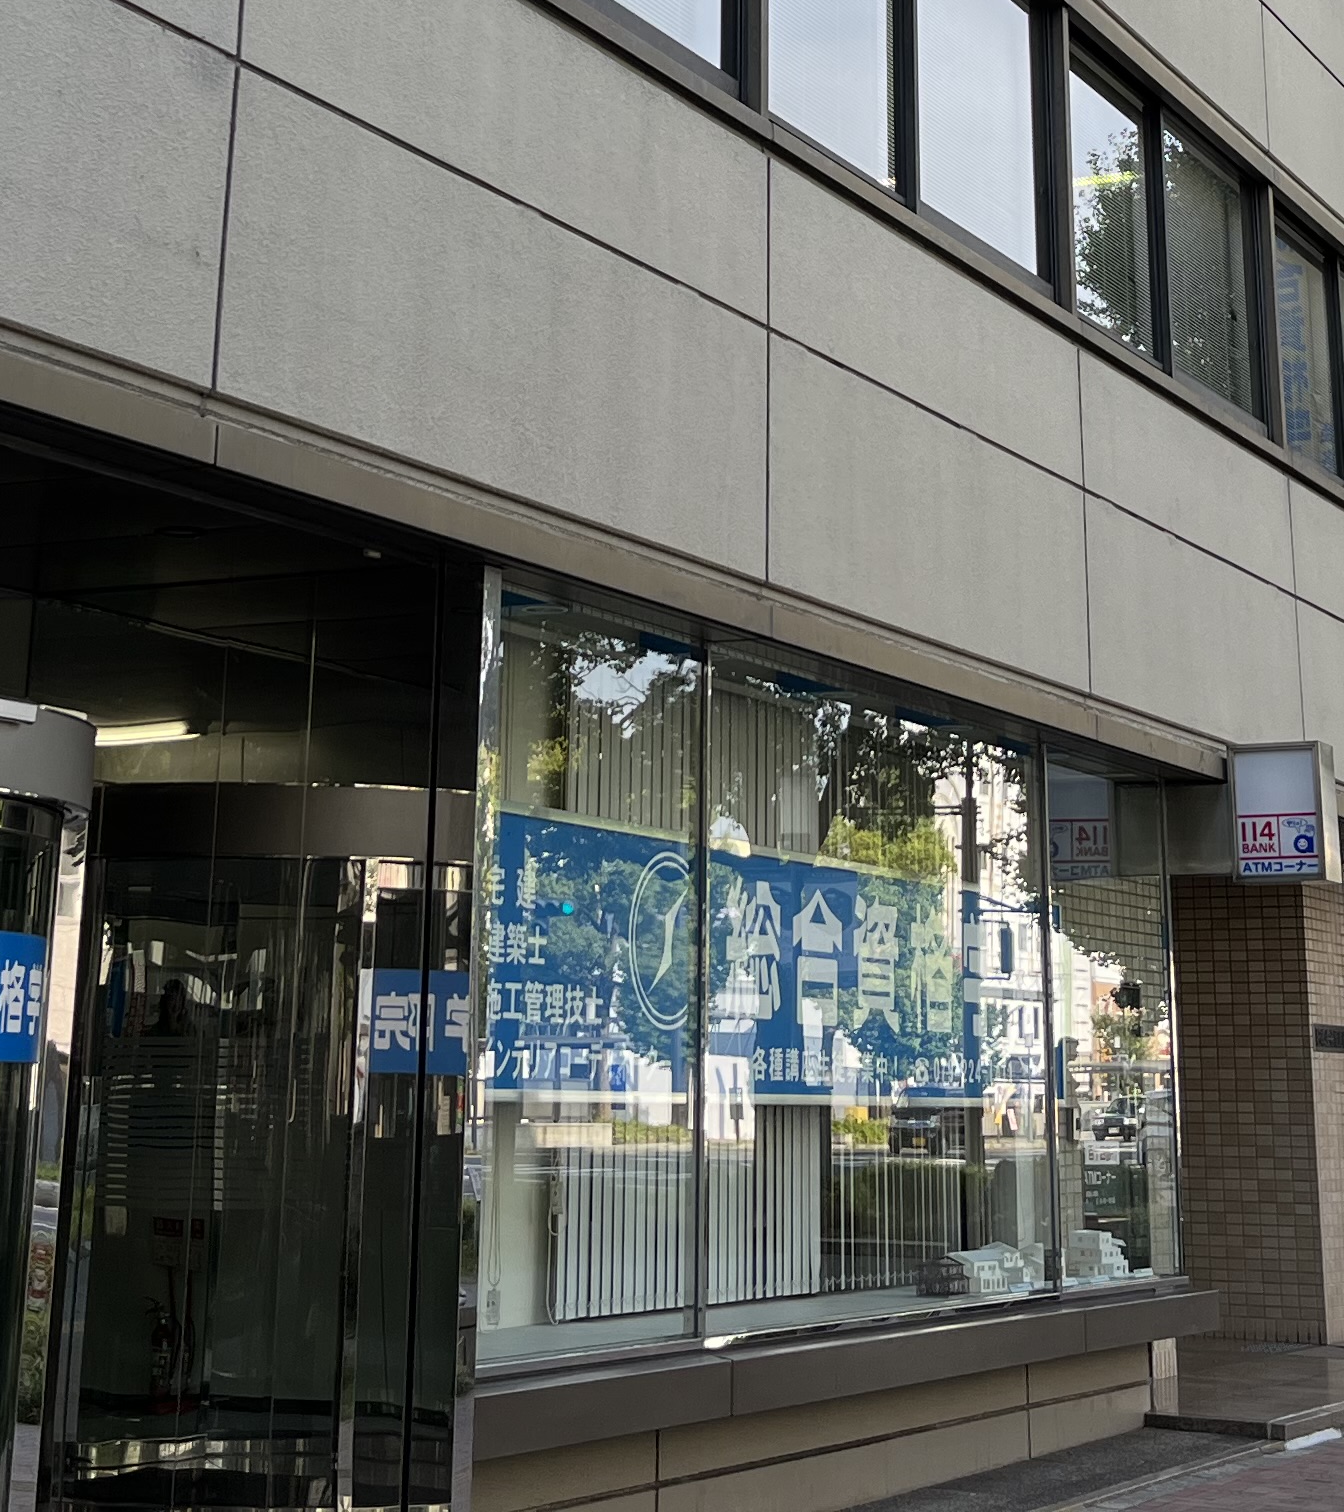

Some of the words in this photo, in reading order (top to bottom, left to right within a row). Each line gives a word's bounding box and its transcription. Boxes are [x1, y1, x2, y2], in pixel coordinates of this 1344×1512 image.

[1241, 820, 1275, 841] 114
[1242, 842, 1276, 854] BANK
[1242, 860, 1318, 873] ATMコーナー
[488, 921, 547, 965] 建築士
